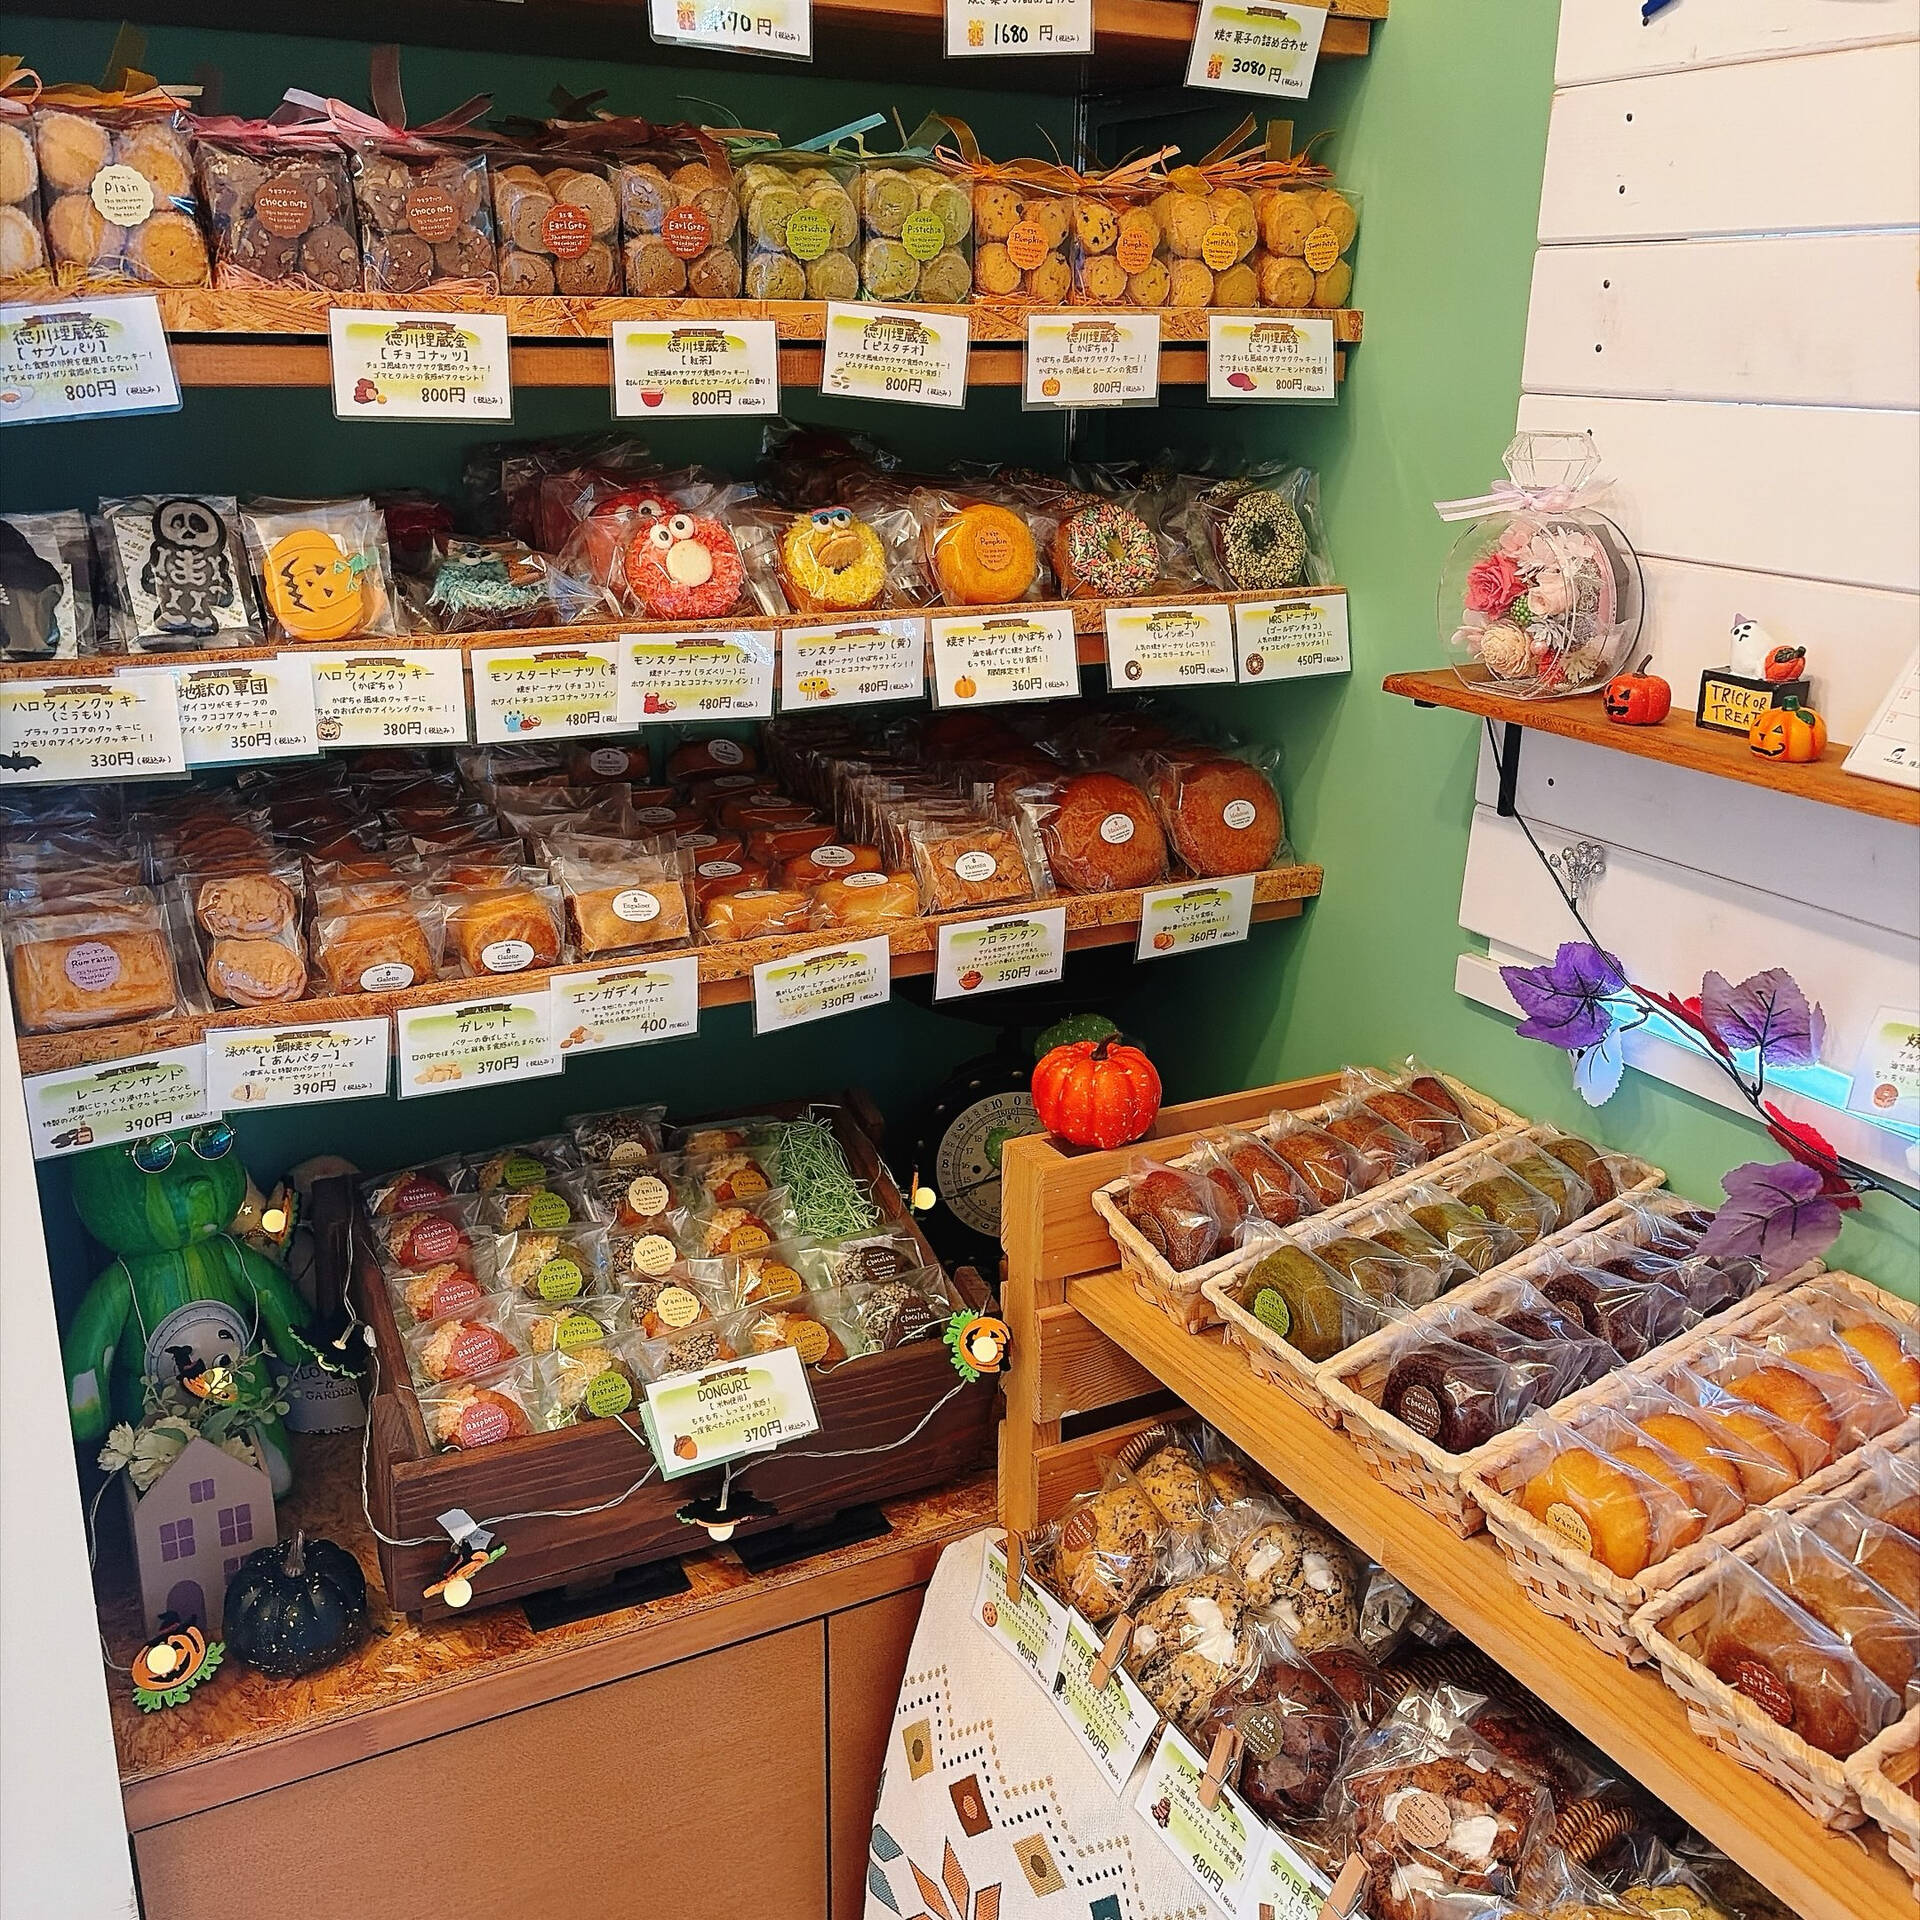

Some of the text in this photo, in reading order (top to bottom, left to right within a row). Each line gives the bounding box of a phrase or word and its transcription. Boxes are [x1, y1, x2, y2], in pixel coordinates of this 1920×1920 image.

[993, 24, 1028, 45] 1680
[104, 181, 140, 195] Plain
[12, 321, 110, 346] 徳川埋蔵金
[384, 331, 469, 349] 徳川埋蔵金
[863, 324, 932, 345] 徳川埋蔵金
[1066, 331, 1122, 343] 徳川埋蔵金
[1249, 331, 1301, 344] 徳川埋蔵金
[667, 340, 730, 354] 徳川埋蔵金
[65, 379, 117, 401] 800円
[885, 376, 923, 394] 800円
[1092, 380, 1122, 394] 800円
[1275, 378, 1303, 391] 800円
[421, 386, 466, 404] 800円
[691, 389, 732, 406] 800円
[1297, 652, 1323, 666] 450円
[317, 668, 436, 681] ハロウィンクッキー
[1178, 662, 1206, 677] 450円
[178, 678, 269, 700] 地獄の軍団
[857, 679, 889, 695] 480円
[1011, 677, 1043, 692] 360円
[12, 695, 147, 712] ハロウィンクッキー
[698, 696, 732, 711] 480円
[1711, 684, 1766, 711] TRICK OR
[565, 711, 600, 727] 480円
[383, 721, 422, 736] 380円
[230, 732, 271, 749] 350円
[89, 751, 134, 768] 330円
[1172, 897, 1223, 914] マドレーヌ
[978, 928, 1040, 947] フロランタン
[1188, 928, 1219, 944] 360円
[788, 958, 859, 981] フィナンシェ
[998, 965, 1031, 982] 350円
[572, 981, 671, 1004] エンガディナー
[820, 992, 855, 1011] 330円
[458, 1016, 512, 1033] ガレット
[640, 1017, 668, 1034] 400
[224, 1035, 377, 1058] 泳がない鯛焼きくんサンド
[477, 1055, 519, 1075] 370円
[76, 1068, 185, 1101] レーズンサンド
[292, 1079, 336, 1096] 390円
[124, 1110, 172, 1133] 390円
[634, 1186, 663, 1197] Vanilla
[639, 1244, 669, 1257] Vanilla
[543, 1271, 578, 1284] Pistachio
[439, 1288, 475, 1305] Raspberry
[662, 1294, 693, 1306] Vanilla
[562, 1328, 599, 1339] Pistachio
[457, 1337, 493, 1359] Raspberry
[305, 1386, 358, 1401] GARDEN
[591, 1382, 627, 1399] Pistachio
[696, 1376, 752, 1403] DONGURI
[465, 1412, 503, 1432] Raspberry
[743, 1418, 783, 1444] 370円
[1016, 1639, 1039, 1670] 480円
[1249, 1716, 1276, 1744] Kokuto
[1082, 1722, 1110, 1760] 500円
[1191, 1852, 1225, 1894] 480円
